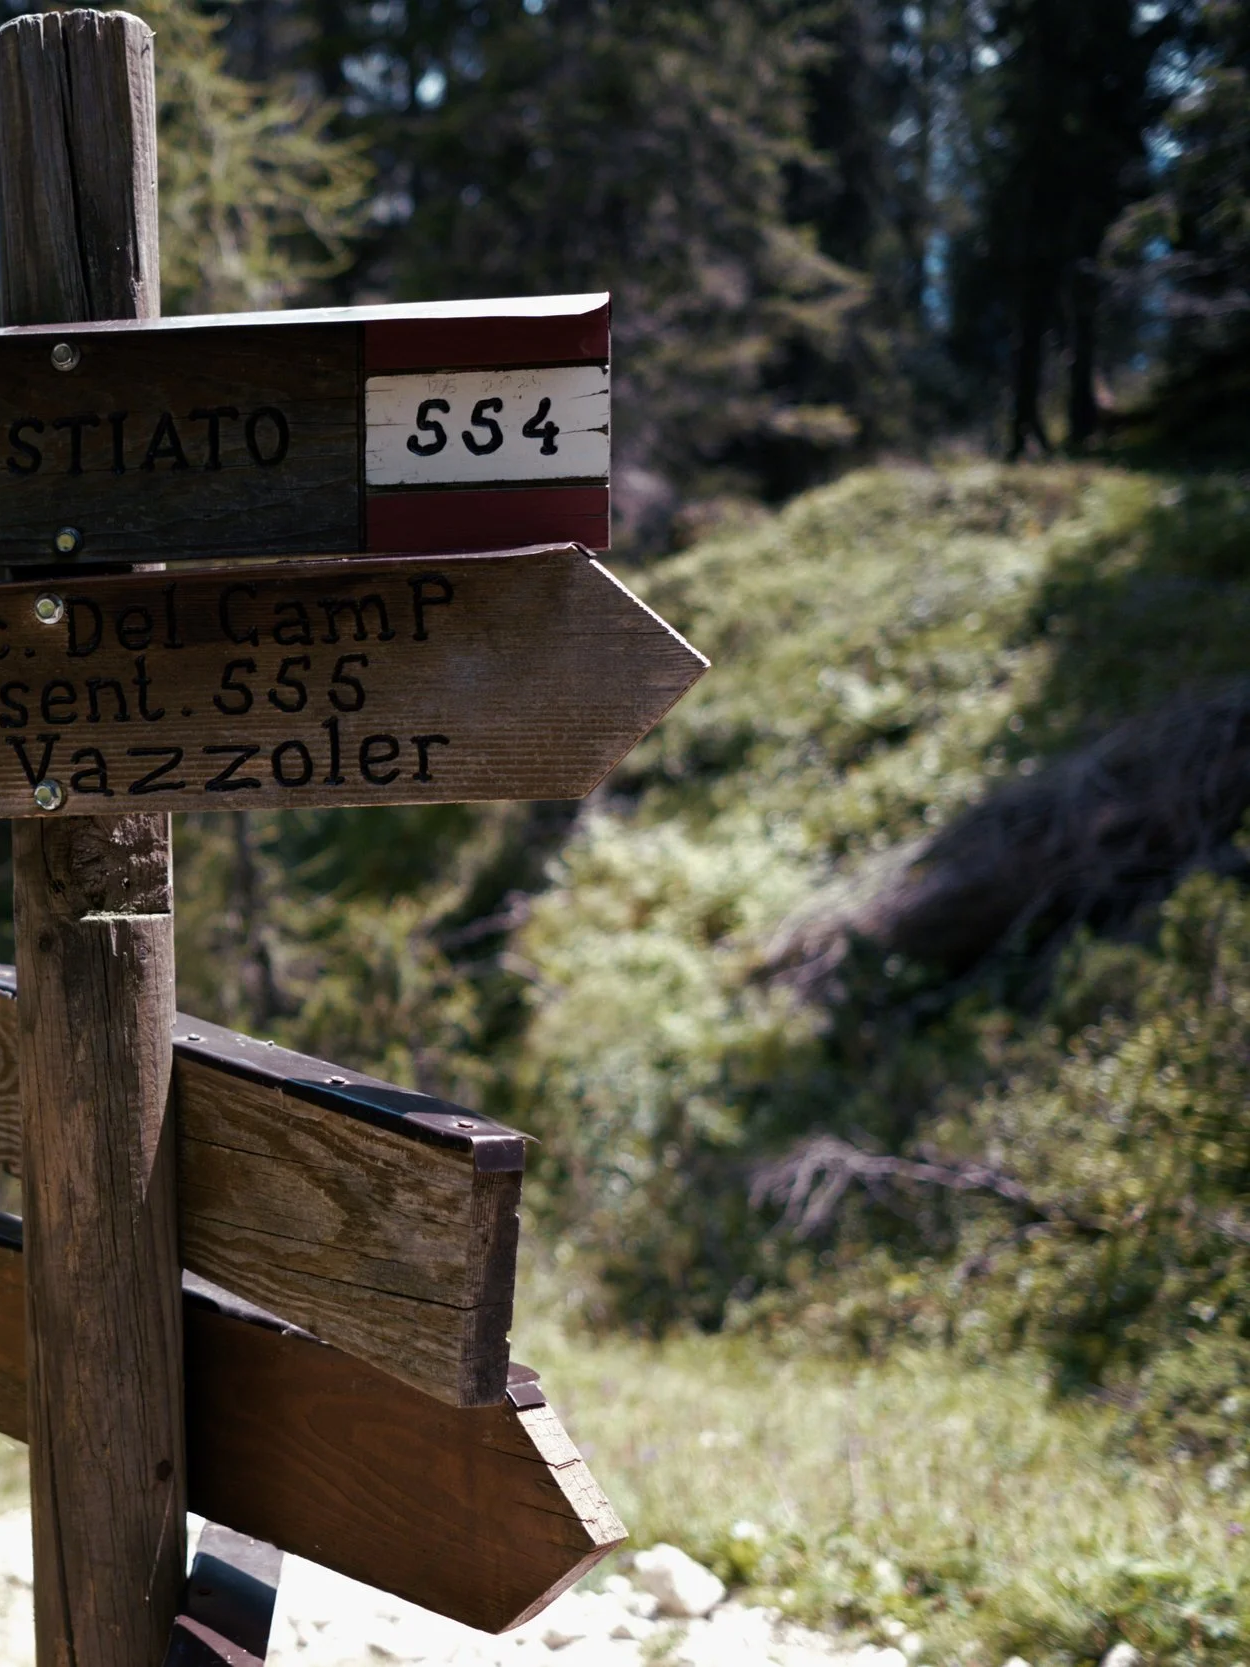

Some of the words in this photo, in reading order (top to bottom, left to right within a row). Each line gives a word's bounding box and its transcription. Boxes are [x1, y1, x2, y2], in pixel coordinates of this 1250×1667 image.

[405, 396, 561, 458] 554
[64, 581, 185, 658] Del
[5, 716, 450, 797] Vazzoler
